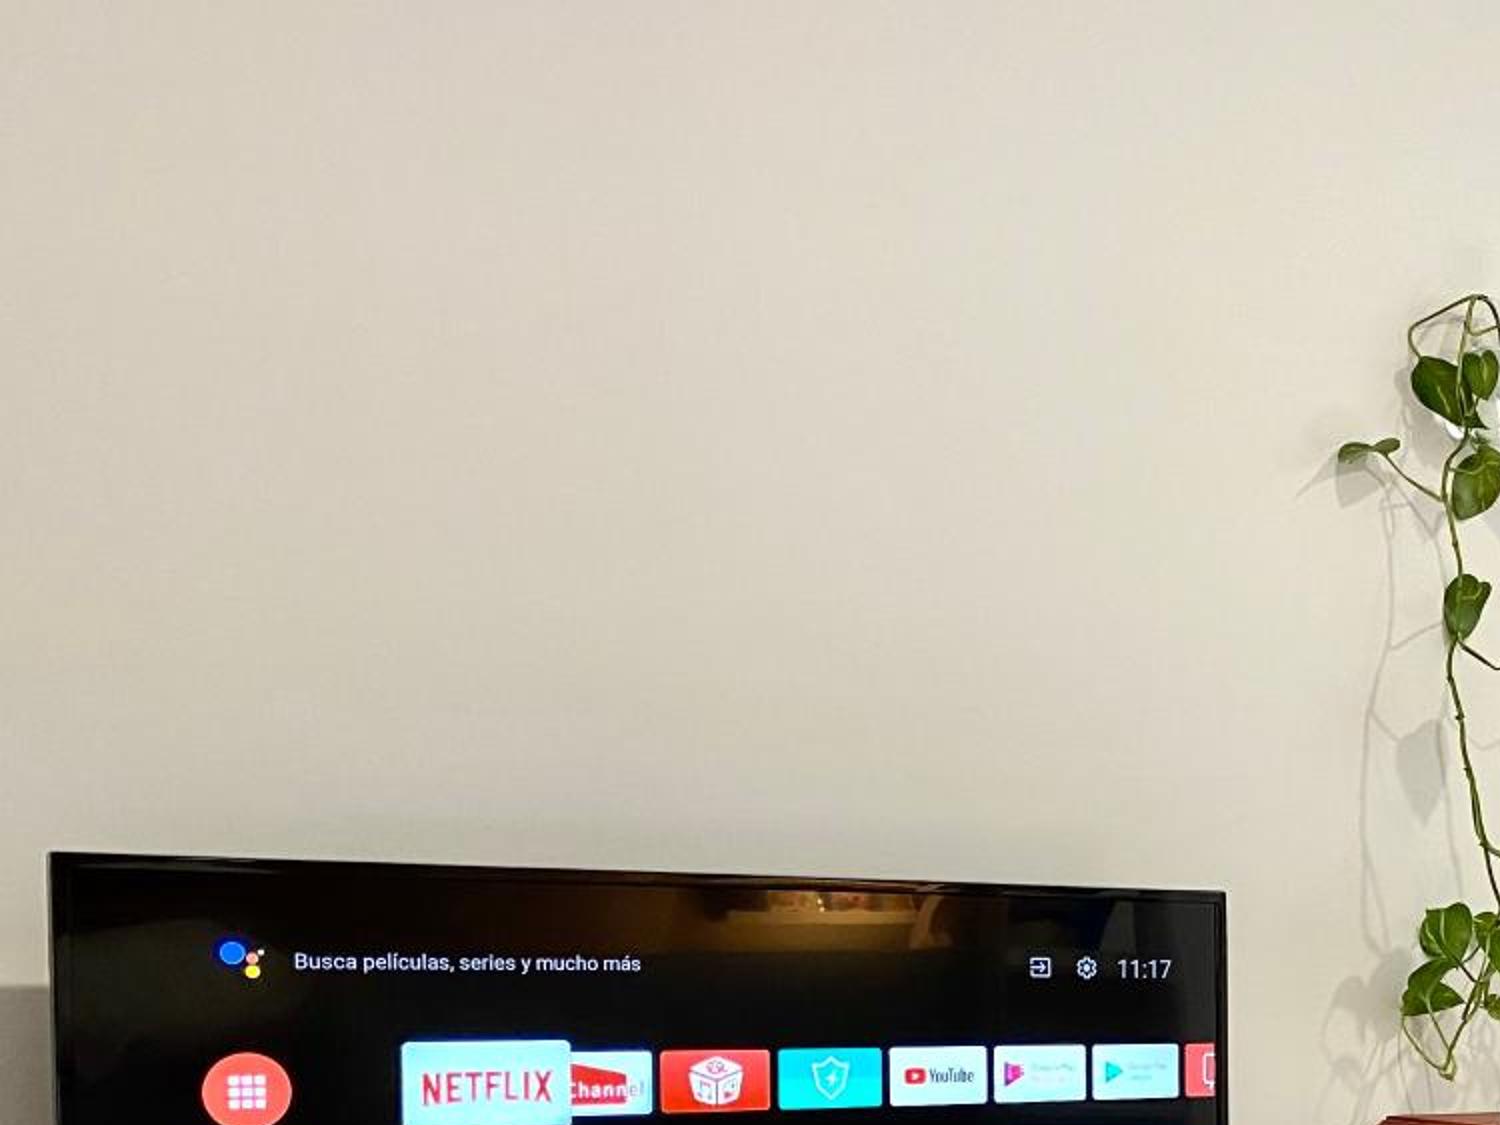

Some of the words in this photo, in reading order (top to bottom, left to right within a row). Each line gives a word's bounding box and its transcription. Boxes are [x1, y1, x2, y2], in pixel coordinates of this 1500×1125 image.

[294, 951, 357, 971] Busca
[363, 951, 455, 975] películas,
[459, 953, 516, 971] series
[520, 956, 532, 975] y
[535, 954, 599, 972] mucho
[603, 955, 641, 972] más
[1117, 959, 1172, 979] 11:17
[929, 1066, 975, 1083] YouTube
[422, 1070, 553, 1106] NETFLIX
